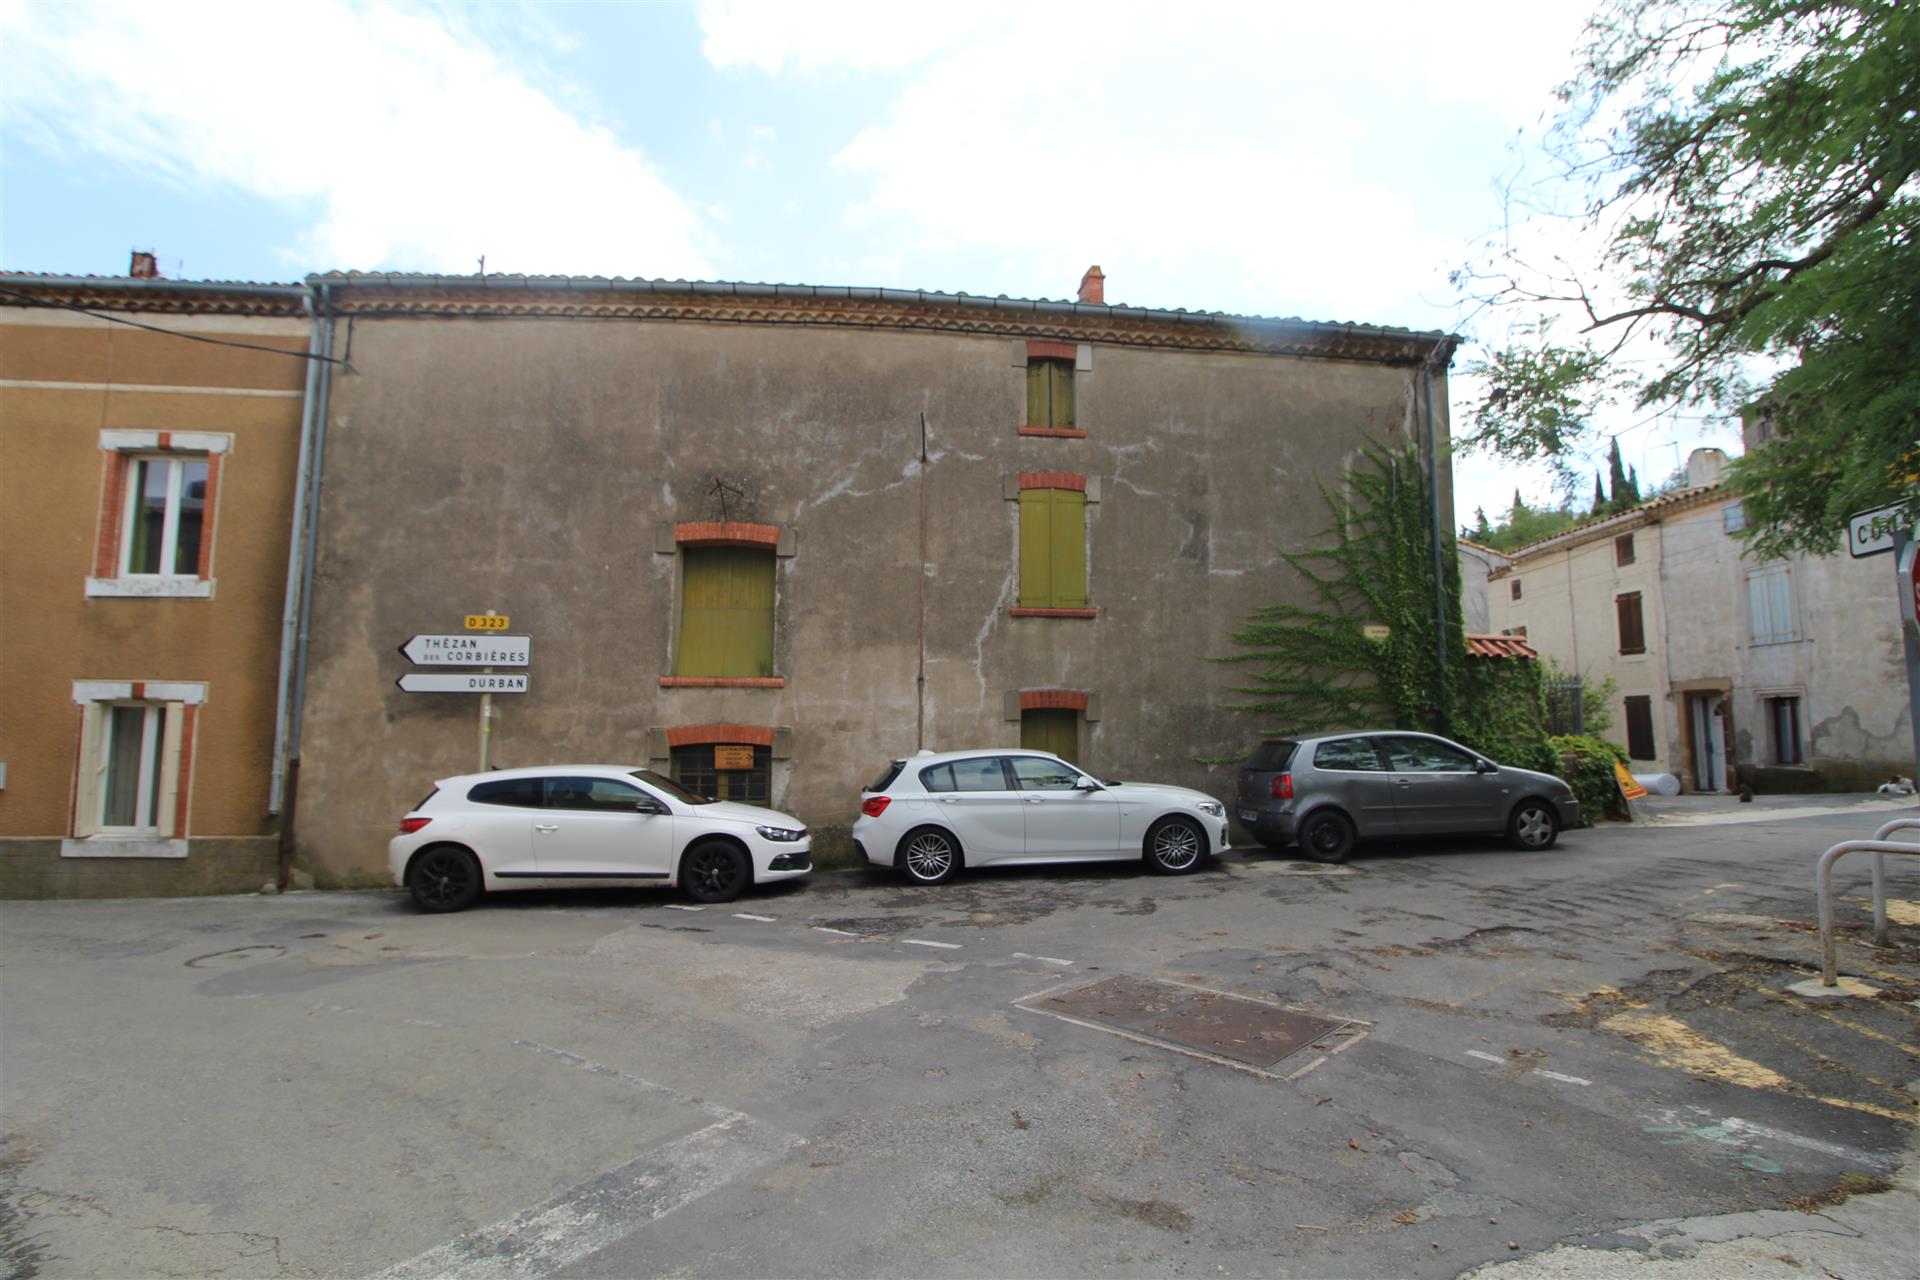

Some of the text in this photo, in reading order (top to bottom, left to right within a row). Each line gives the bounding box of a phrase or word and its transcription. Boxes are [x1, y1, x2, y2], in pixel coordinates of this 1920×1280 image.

[480, 618, 505, 627] 323
[425, 638, 477, 648] THÉZAN
[447, 651, 525, 662] CORBIÈRES
[469, 679, 524, 688] DURBAN
